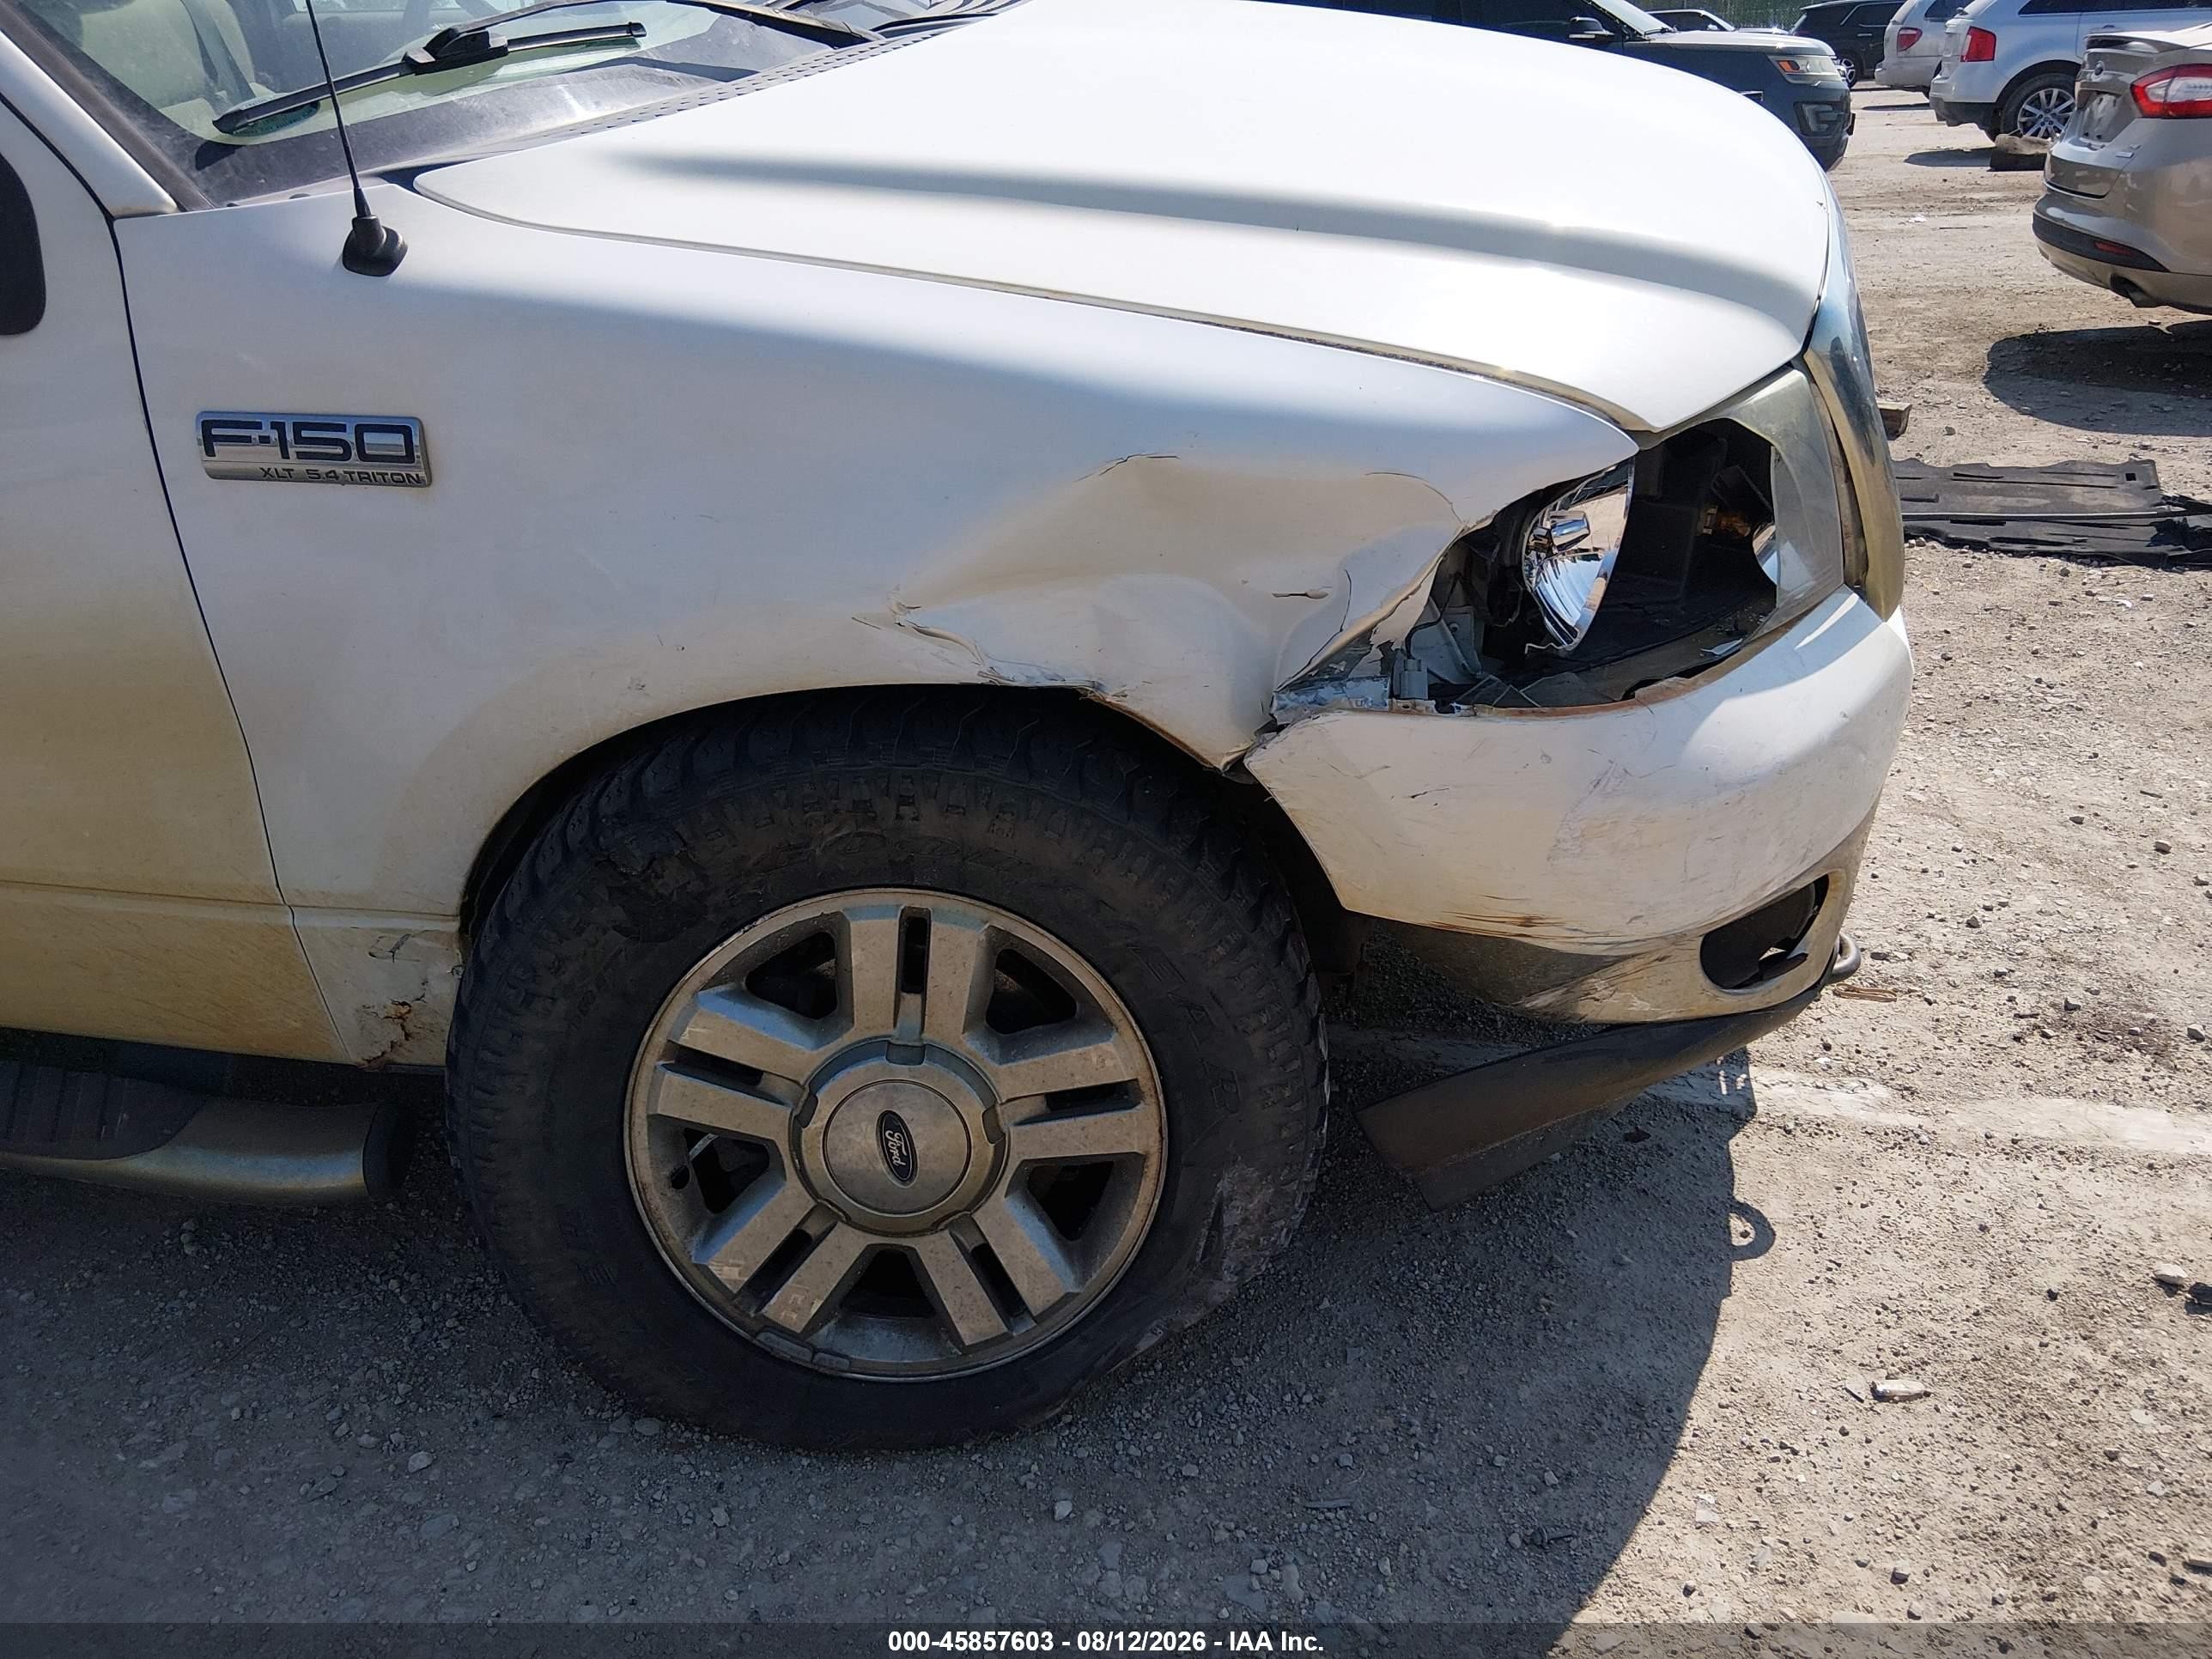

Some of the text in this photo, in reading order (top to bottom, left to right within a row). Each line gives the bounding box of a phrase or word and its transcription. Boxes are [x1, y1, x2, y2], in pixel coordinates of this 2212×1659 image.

[201, 419, 416, 464] F-150
[260, 467, 422, 484] XLT 5.4 TRITON
[885, 1130, 907, 1166] Ford
